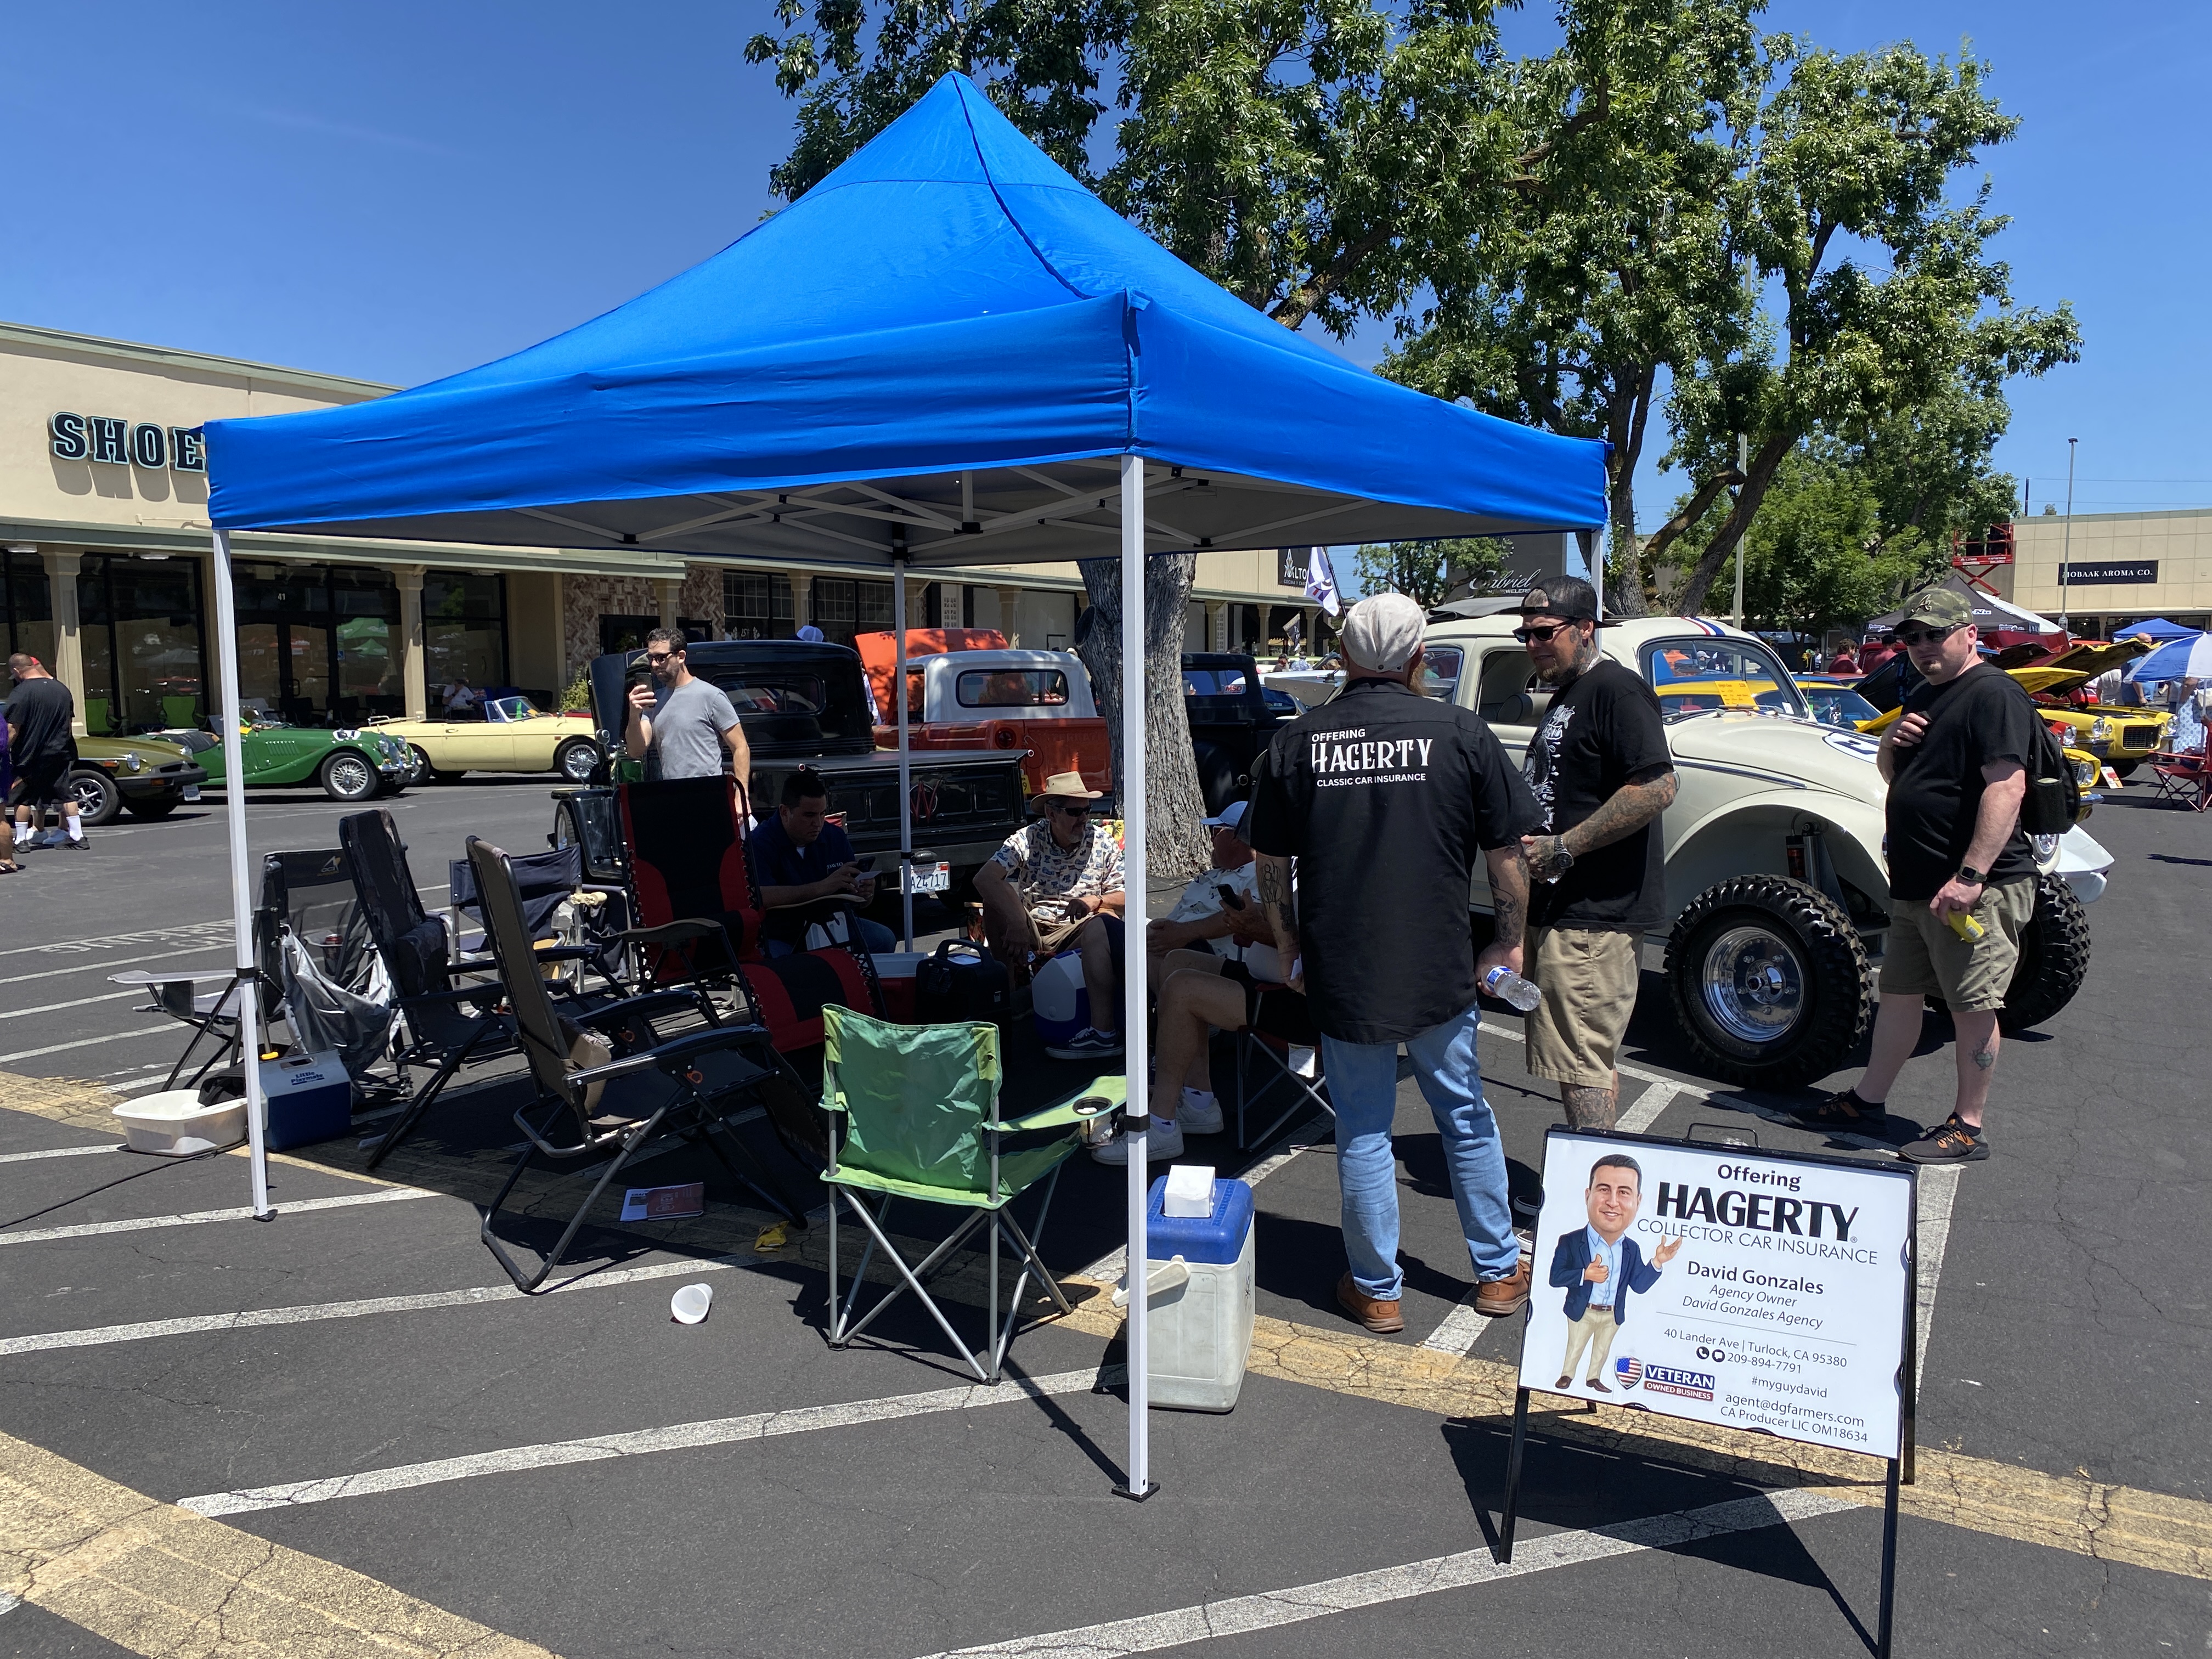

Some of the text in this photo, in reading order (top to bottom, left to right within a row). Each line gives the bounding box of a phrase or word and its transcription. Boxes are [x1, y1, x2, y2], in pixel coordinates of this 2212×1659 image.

[49, 411, 206, 473] SHOE
[1312, 729, 1365, 742] OFFERING
[1312, 739, 1433, 773] HAGERTY
[1317, 773, 1426, 787] CLASSIC CAR INSURANCE
[911, 873, 946, 889] A24717
[291, 1074, 323, 1083] Playmate
[1718, 1164, 1802, 1192] Offering
[1656, 1181, 1859, 1242] HAGERTY
[1638, 1218, 1878, 1265] COLLECTOR CAR INSURANCE
[1688, 1261, 1824, 1295] David Gonzales
[1709, 1284, 1797, 1307] Agency Owner
[1683, 1295, 1824, 1330] David Gonzales Agency
[1664, 1328, 1677, 1339] 40
[1680, 1330, 1717, 1345] Lander
[1719, 1336, 1740, 1349] Ave
[1748, 1341, 1790, 1359] Turlock,
[1793, 1349, 1809, 1361] CA
[1812, 1353, 1848, 1368] 95380
[1727, 1352, 1802, 1374] 209-894-7791
[1646, 1365, 1714, 1389] VETERAN
[1751, 1376, 1828, 1398] #myguydavid
[1646, 1382, 1711, 1400] OWNED BUSINESS
[1720, 1406, 1736, 1419] CA
[1739, 1409, 1790, 1428] Producer
[1792, 1418, 1809, 1432] LIC
[1725, 1394, 1865, 1427] agent@dgfarmers.com
